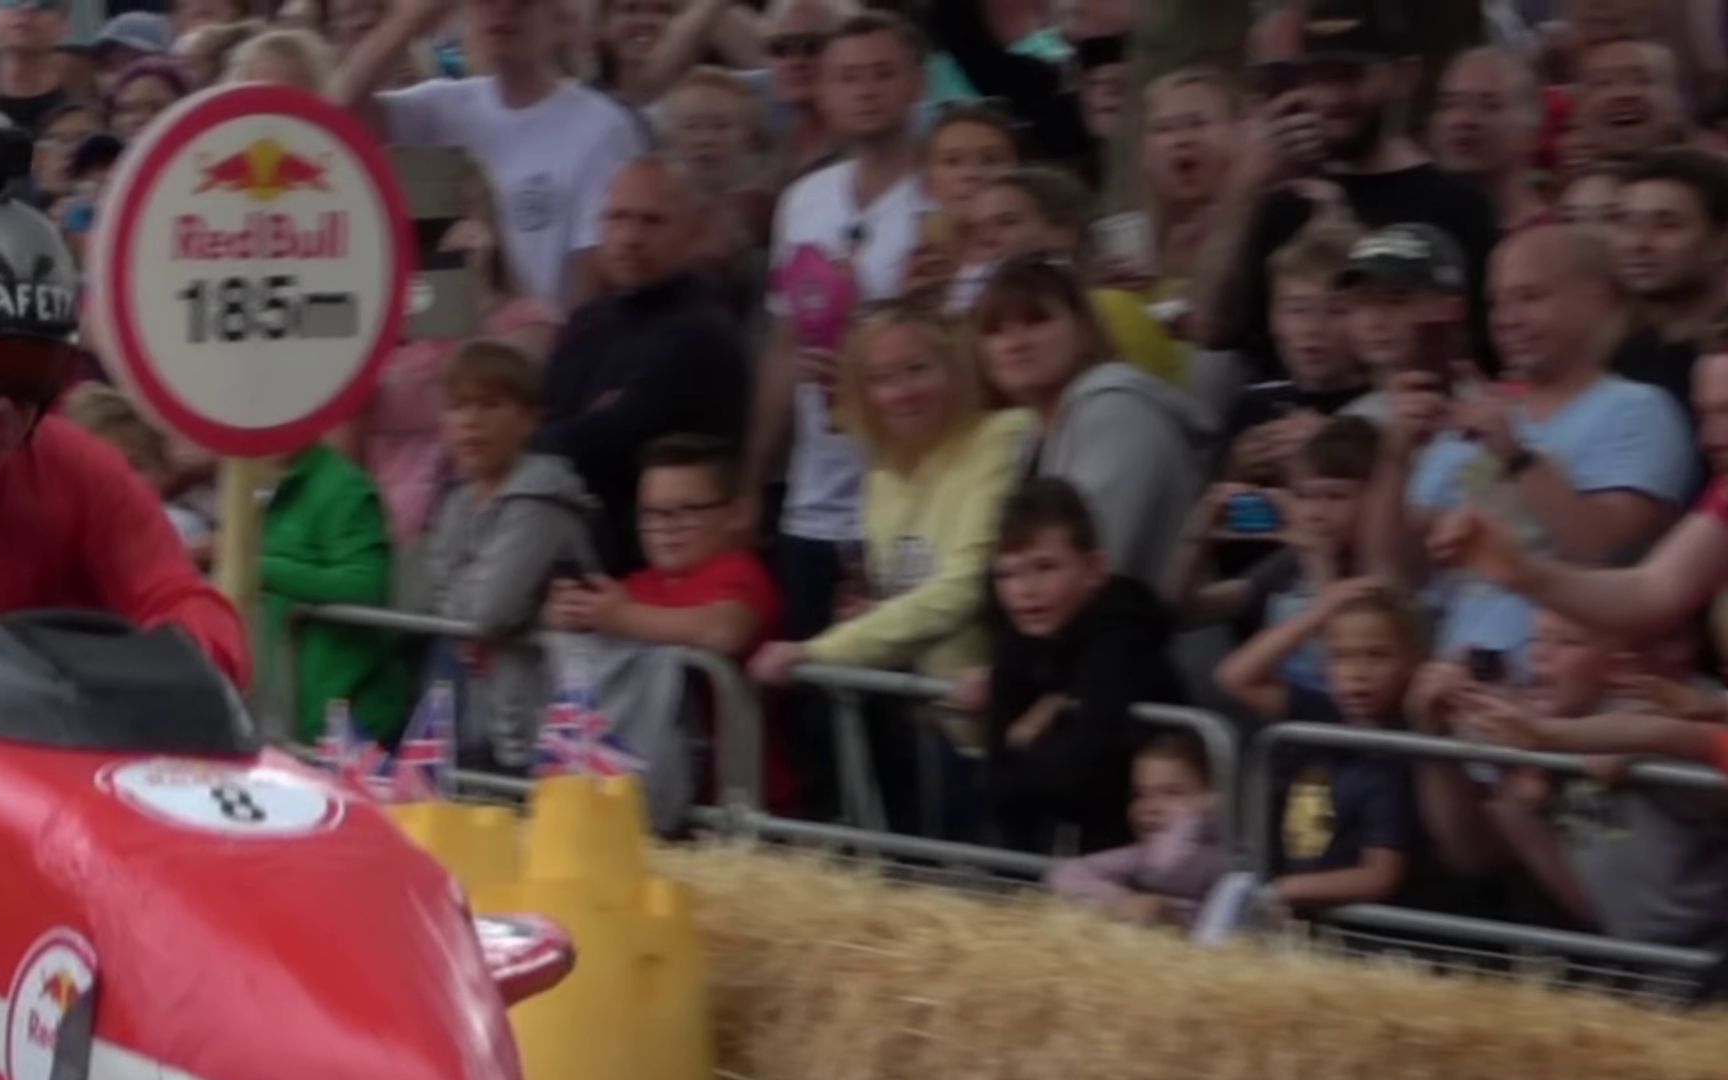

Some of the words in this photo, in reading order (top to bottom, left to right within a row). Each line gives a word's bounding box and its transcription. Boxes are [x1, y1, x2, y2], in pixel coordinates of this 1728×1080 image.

[173, 213, 262, 260] Red
[264, 211, 349, 260] Bull
[177, 274, 359, 342] 185m
[211, 783, 266, 823] 8
